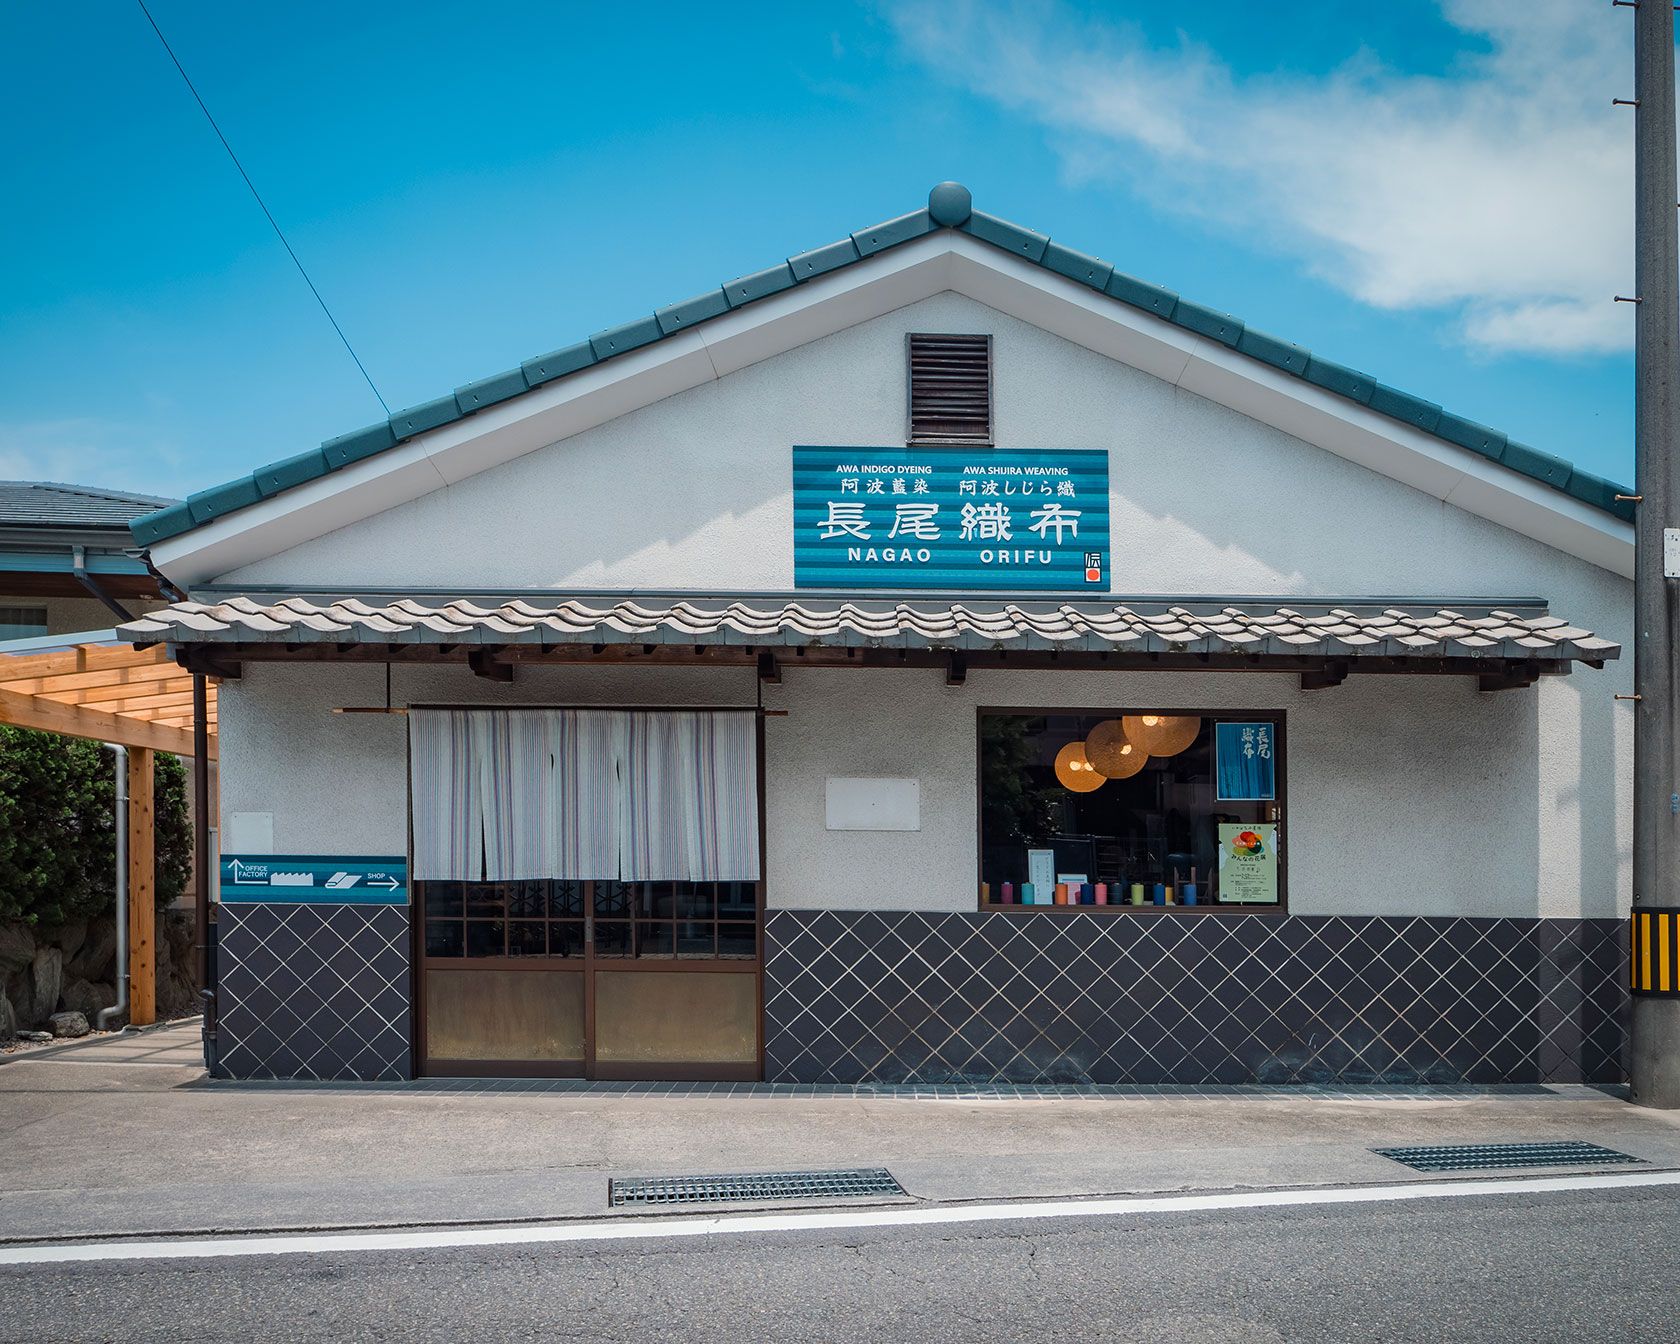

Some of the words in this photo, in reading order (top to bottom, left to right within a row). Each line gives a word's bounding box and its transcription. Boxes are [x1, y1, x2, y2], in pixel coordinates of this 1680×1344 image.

[836, 465, 859, 473] AWA
[861, 465, 895, 474] INDIGO
[897, 465, 932, 474] DYEING
[963, 466, 986, 475] AWA
[988, 466, 1022, 475] SHIJIRA
[1024, 467, 1069, 476] WEAVING
[841, 478, 931, 495] 阿波藍染
[959, 480, 1076, 498] 阿波しじら織
[817, 501, 1082, 546] 長尾織布
[848, 547, 931, 563] NAGAO
[980, 549, 1052, 564] ORIFU
[1256, 727, 1271, 759] 長尾
